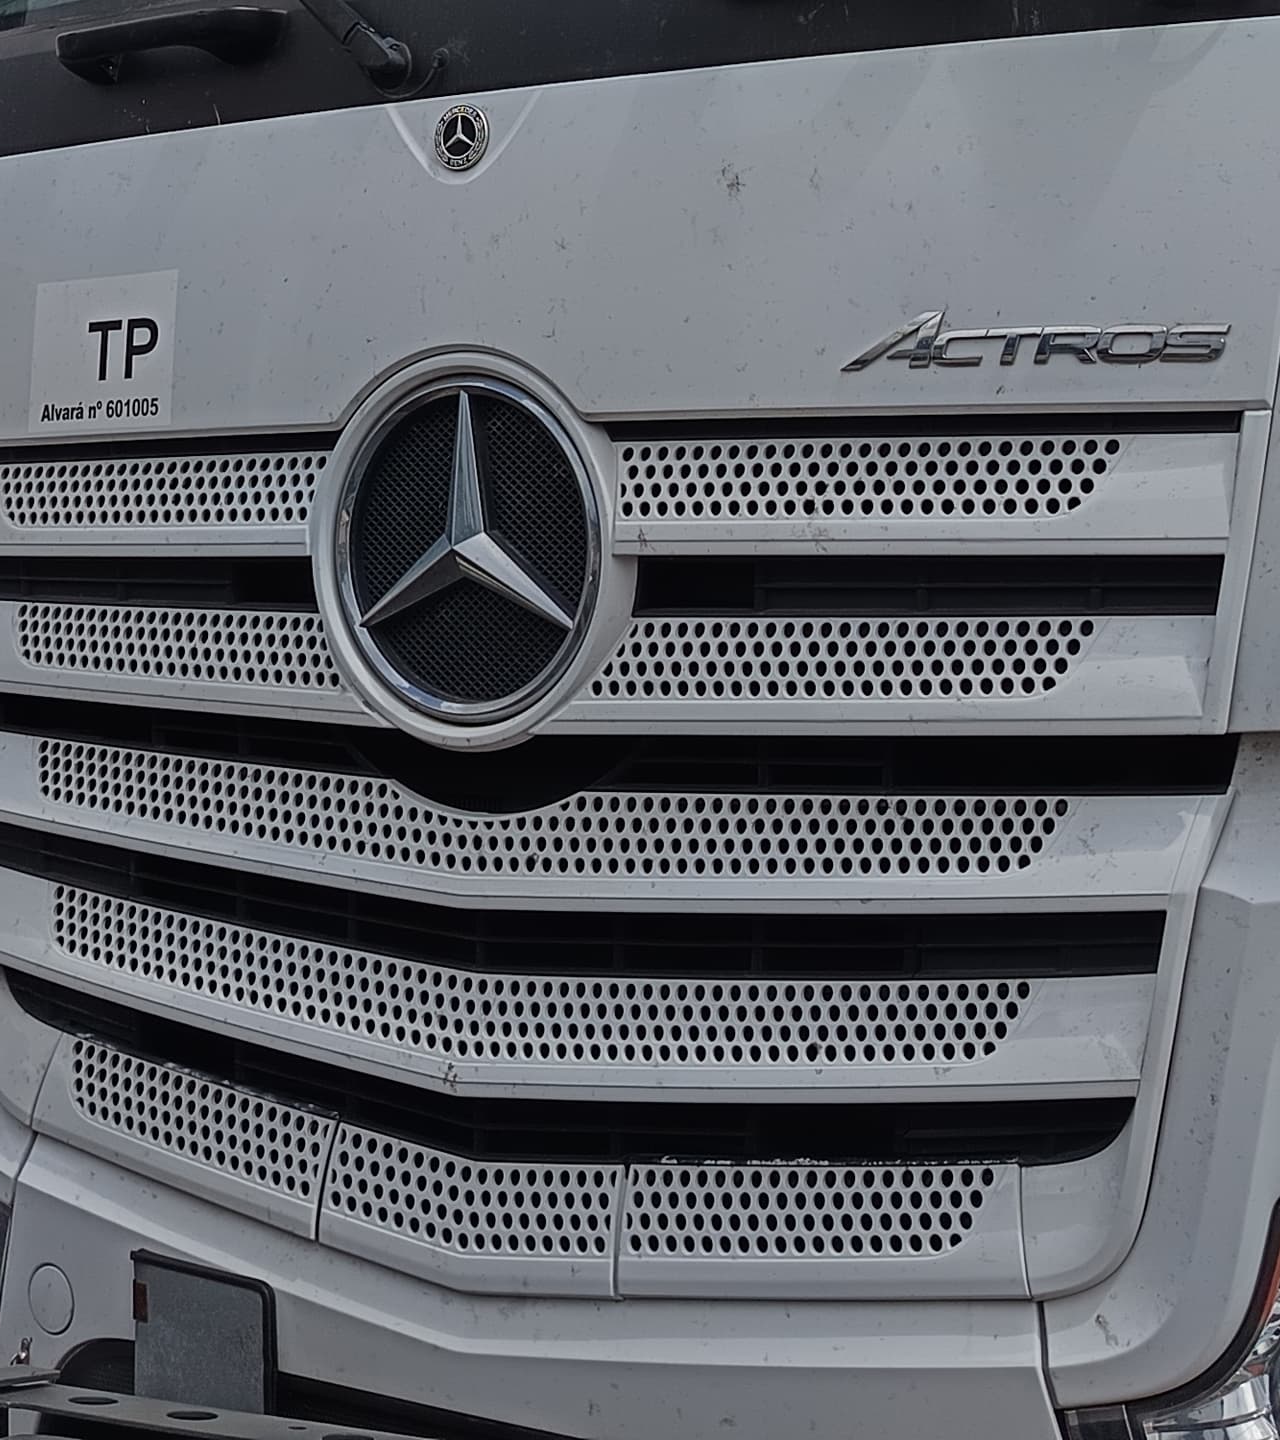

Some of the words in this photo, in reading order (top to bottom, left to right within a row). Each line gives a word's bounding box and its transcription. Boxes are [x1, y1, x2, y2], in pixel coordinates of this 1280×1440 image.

[87, 317, 159, 381] TP
[840, 309, 1232, 372] ACTROS
[41, 401, 84, 422] Alvará
[106, 397, 159, 419] 601005
